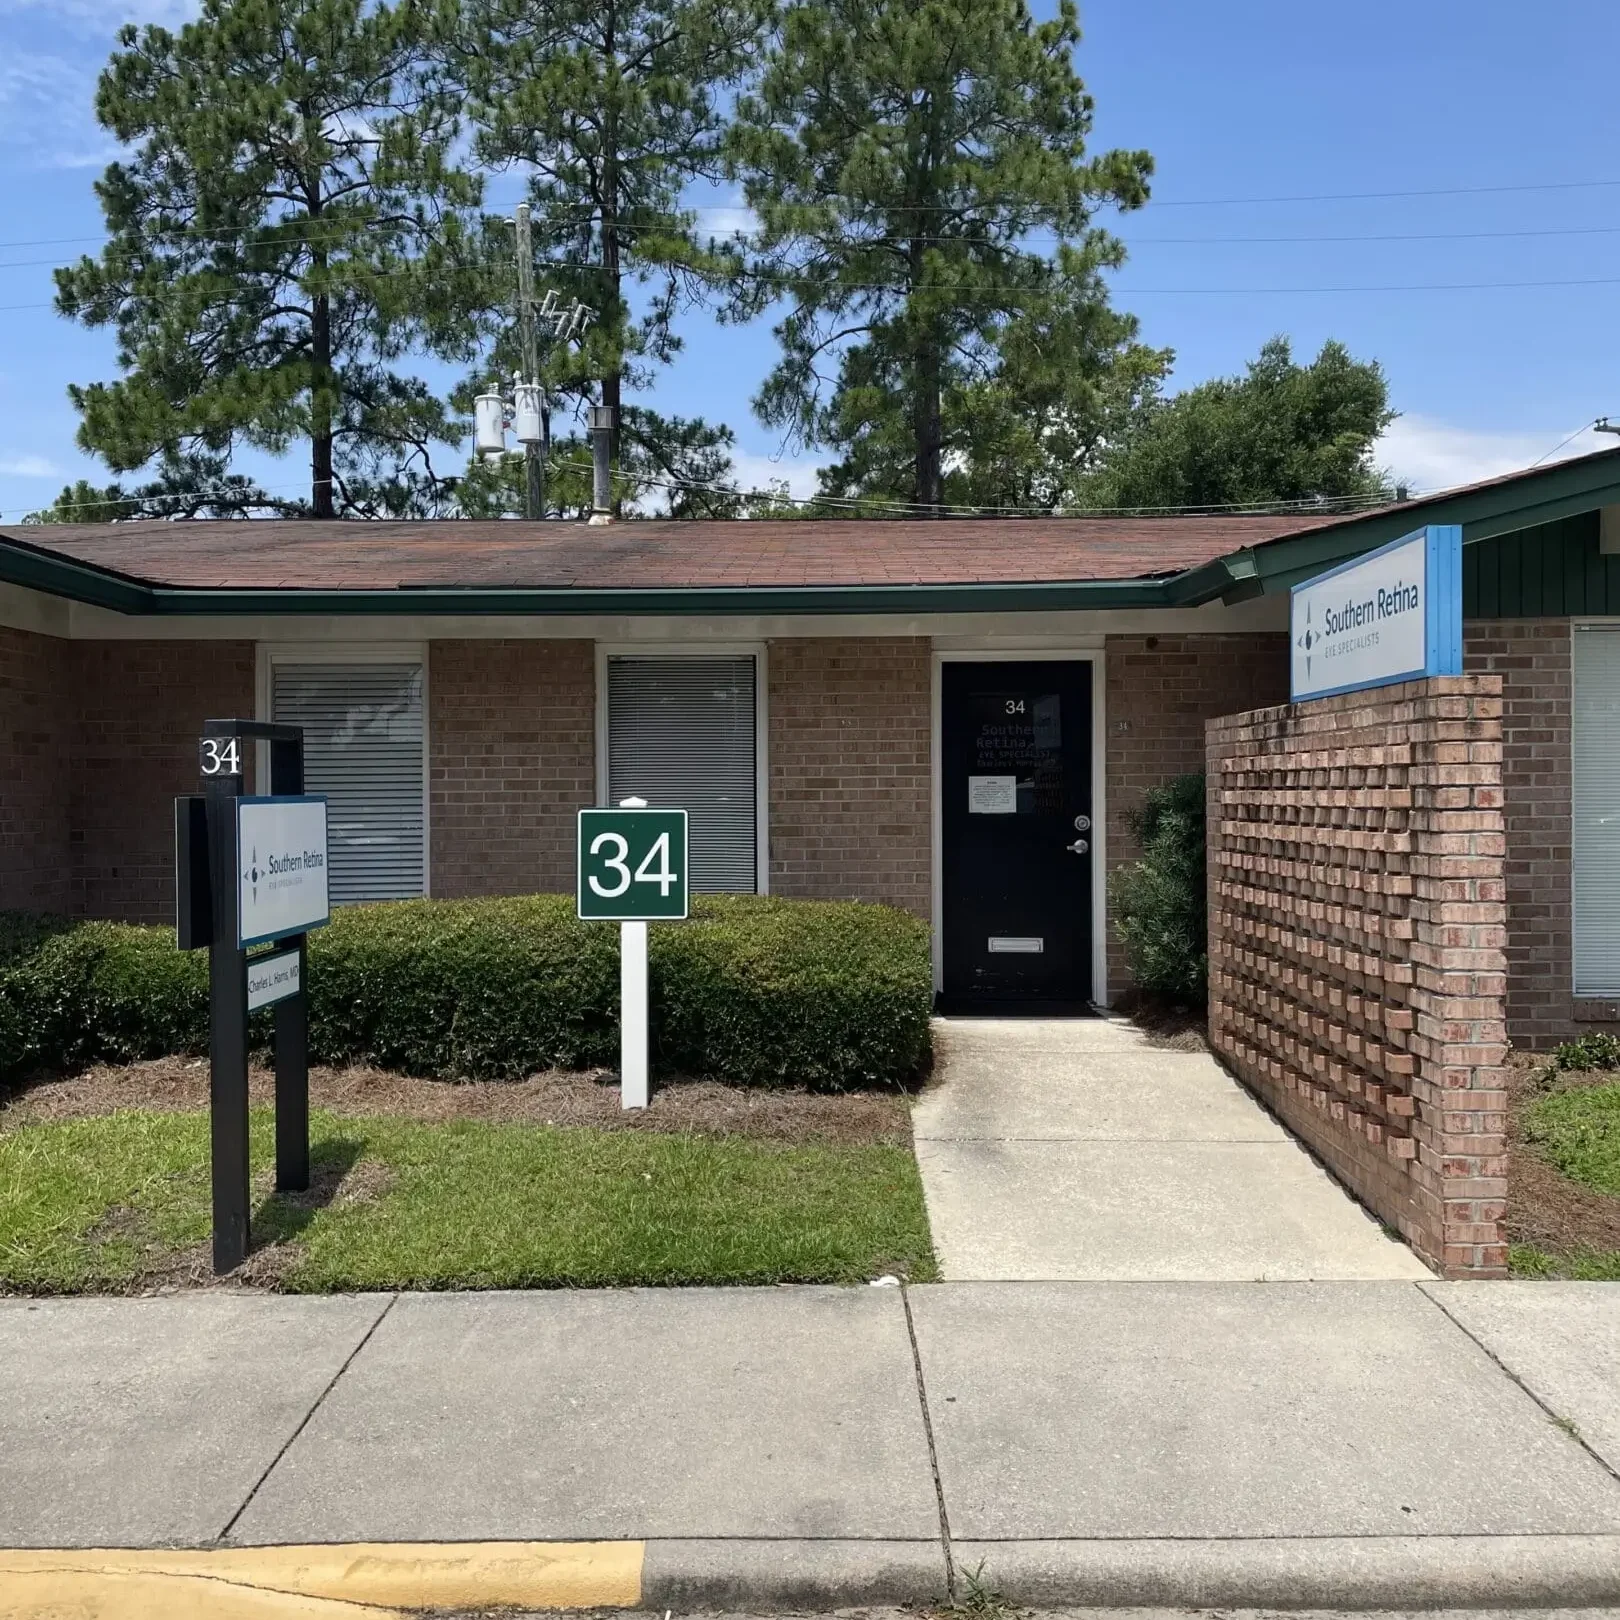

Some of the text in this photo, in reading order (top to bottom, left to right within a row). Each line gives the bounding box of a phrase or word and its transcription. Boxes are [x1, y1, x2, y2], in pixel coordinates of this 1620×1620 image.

[1325, 580, 1418, 636] Southern Retina
[1325, 632, 1380, 658] EYE SPECIALISTS
[1005, 700, 1026, 714] 34
[201, 738, 240, 774] 34
[268, 850, 324, 875] Southern Retina
[588, 832, 678, 898] 34
